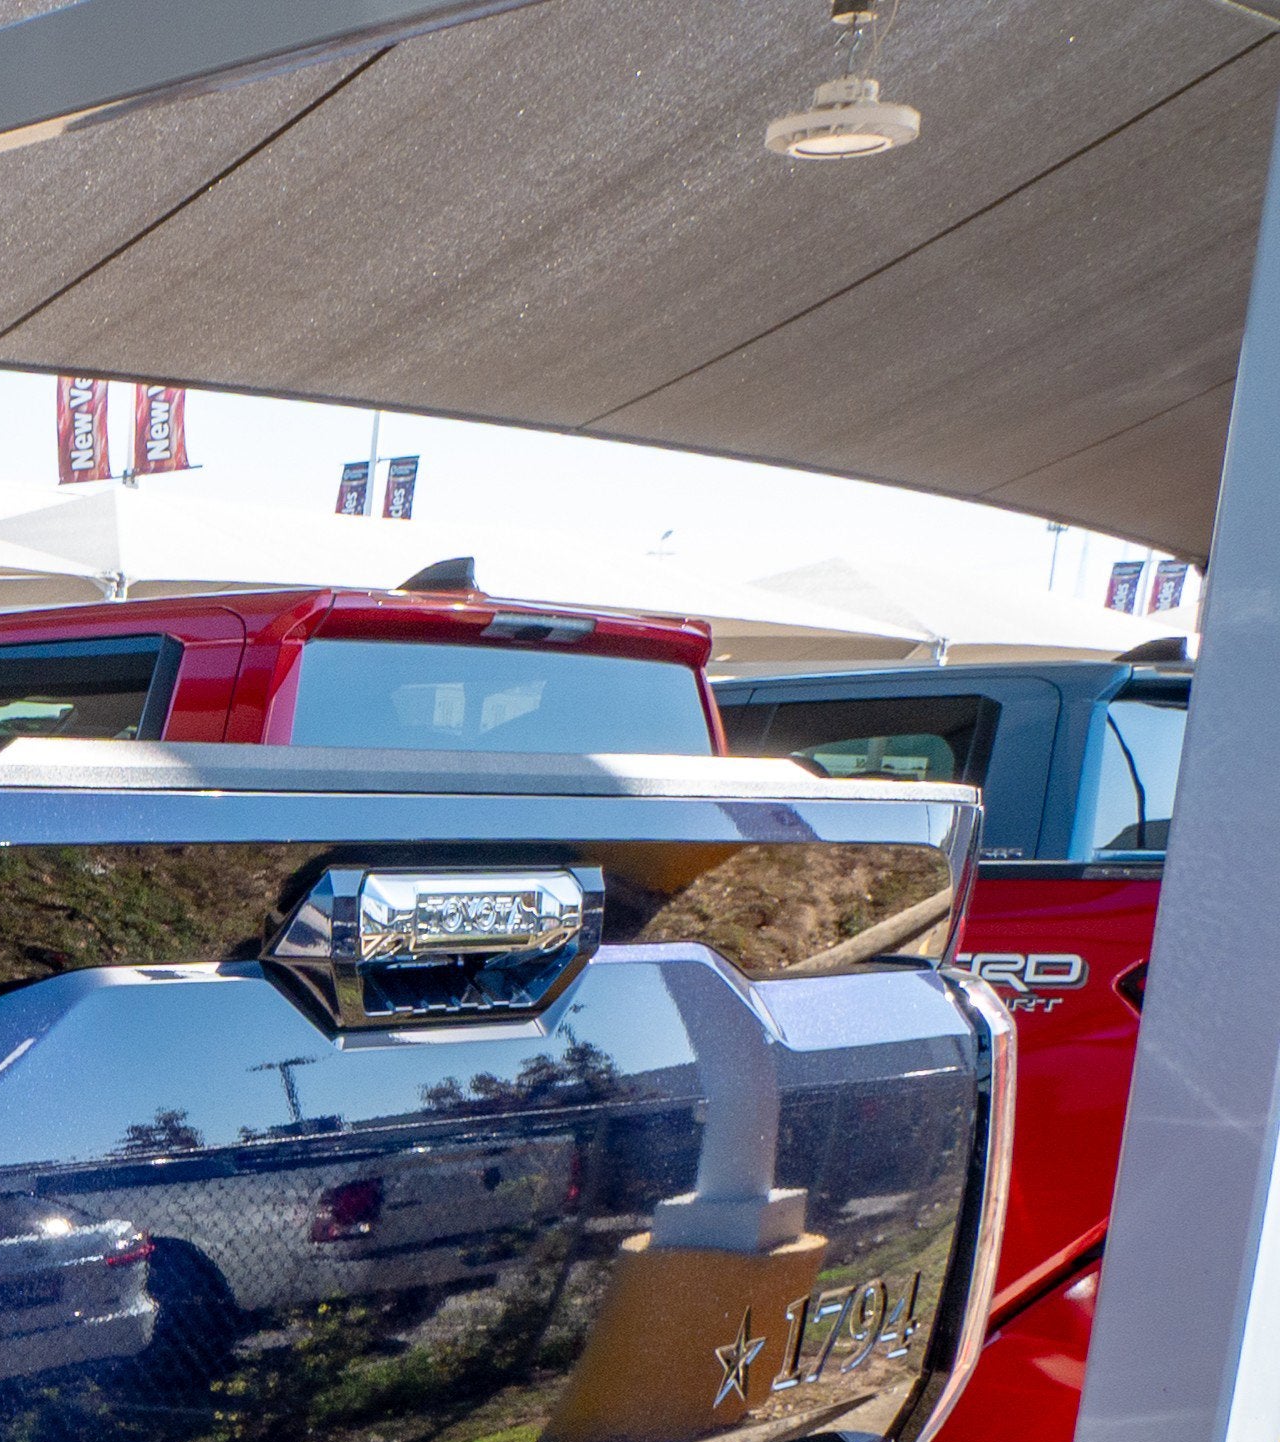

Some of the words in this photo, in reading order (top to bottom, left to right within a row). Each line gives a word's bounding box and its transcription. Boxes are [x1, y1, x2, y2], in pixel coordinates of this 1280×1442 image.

[70, 412, 95, 470] New
[146, 401, 171, 461] New
[418, 896, 534, 932] TOYOTA
[772, 1270, 921, 1391] 1794
